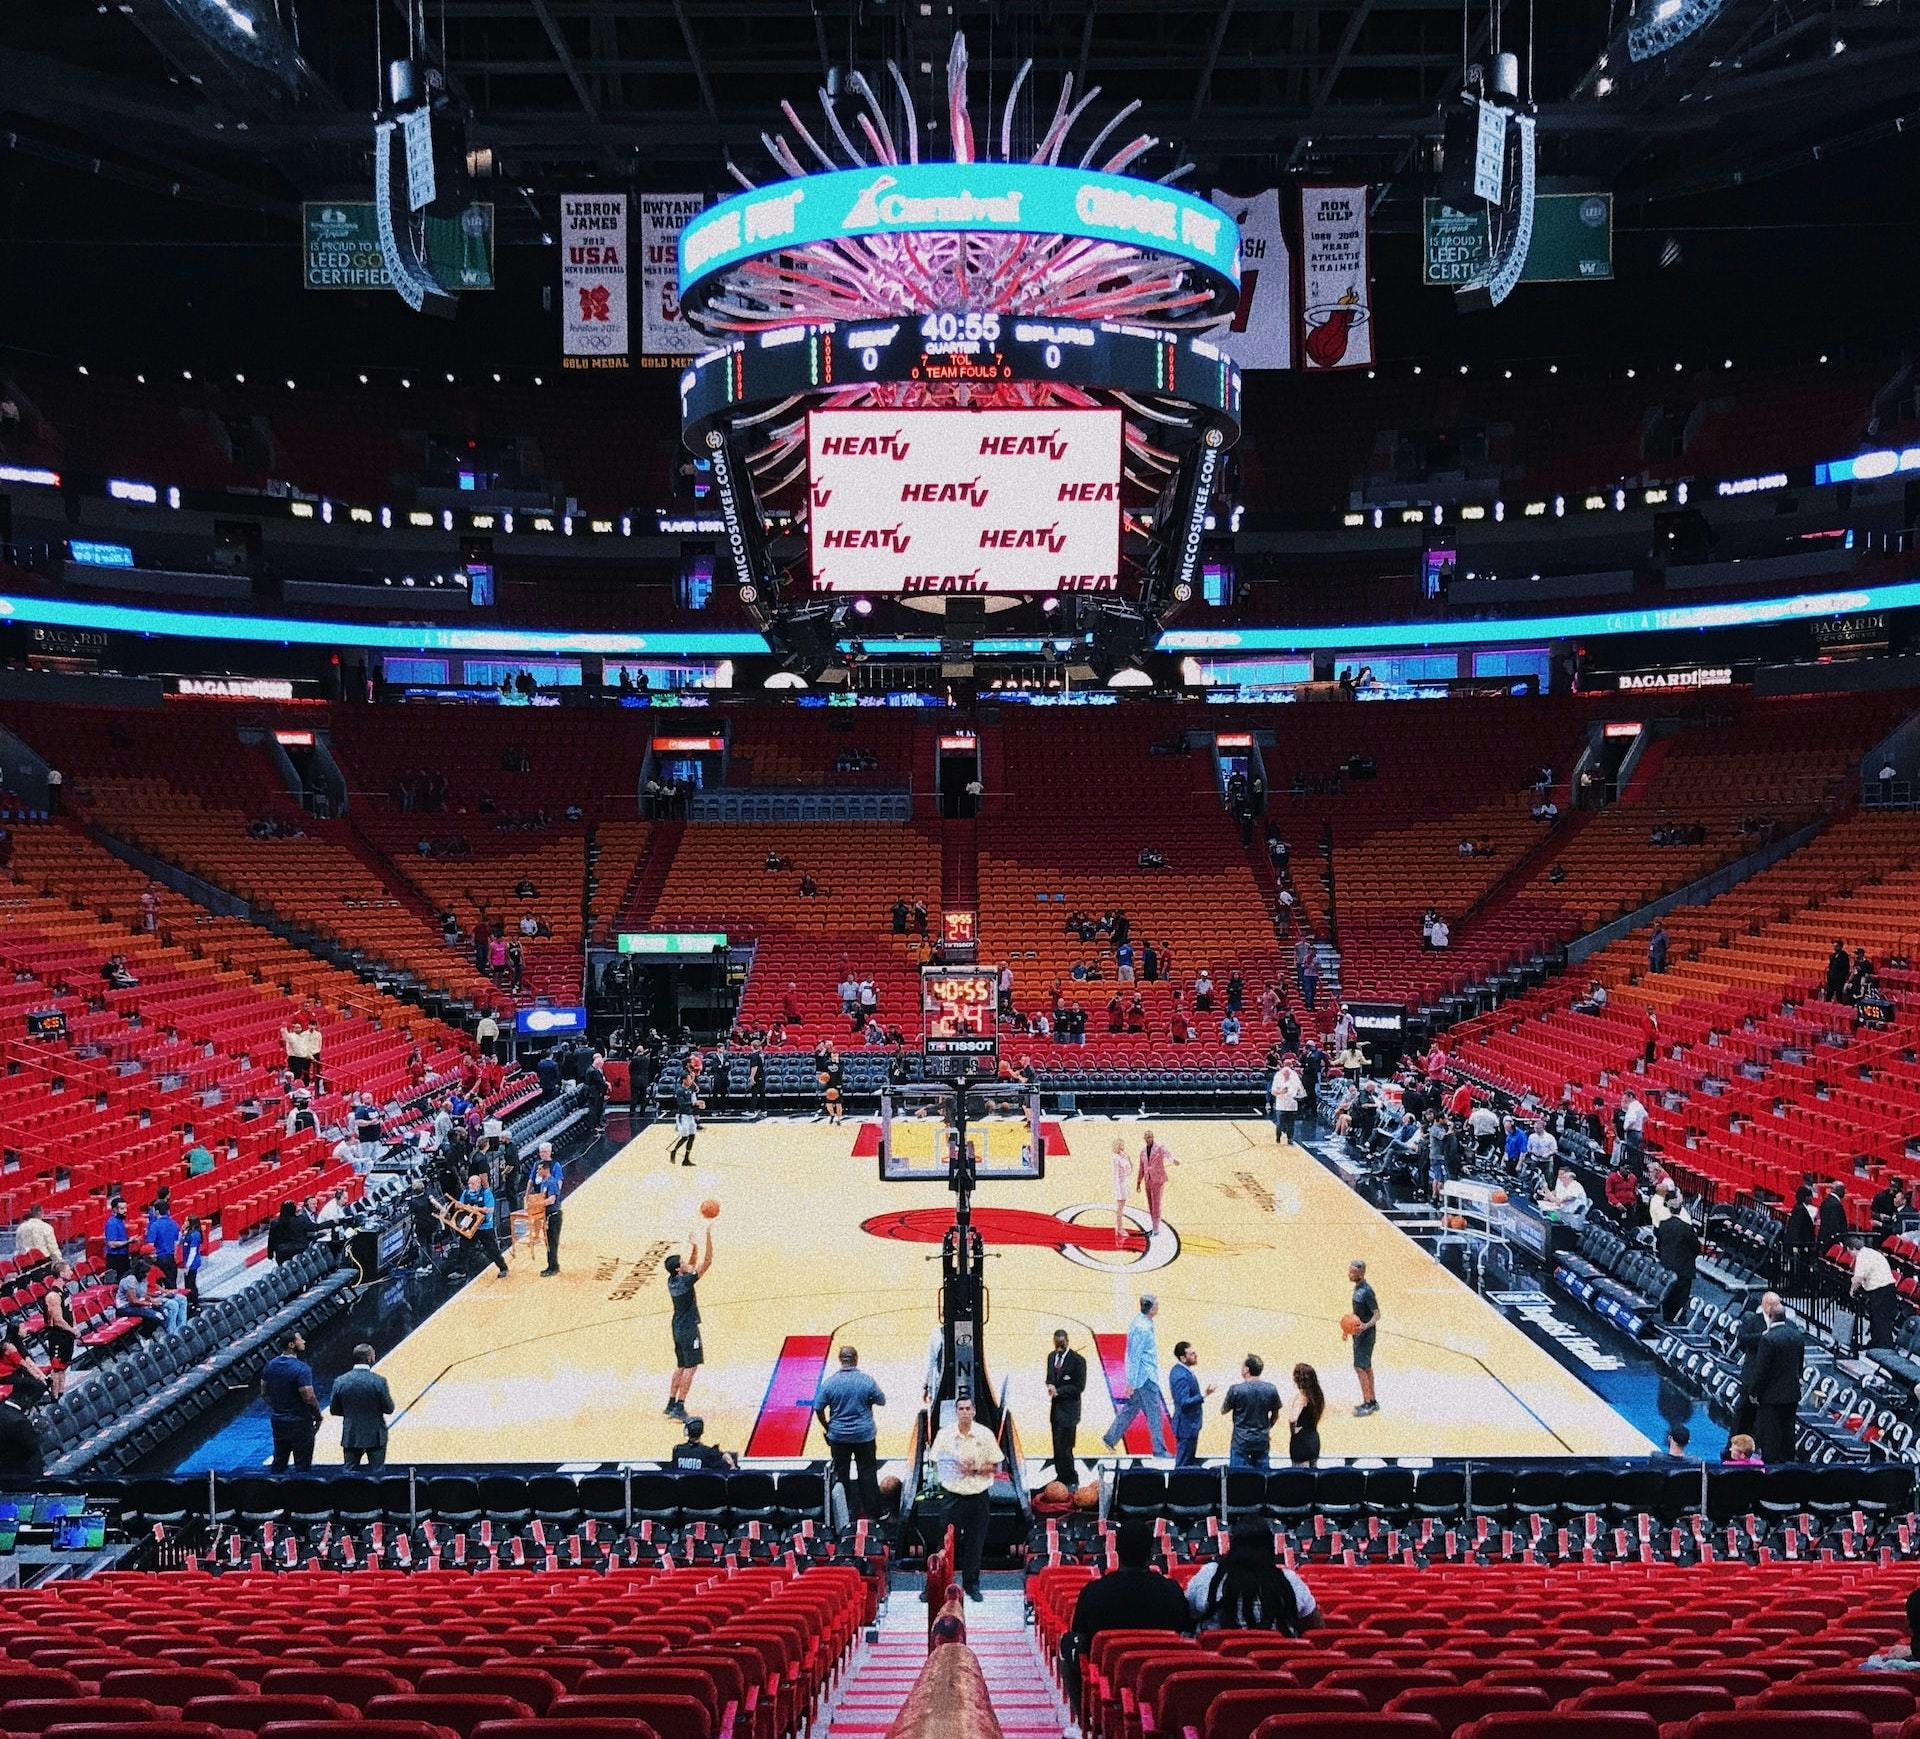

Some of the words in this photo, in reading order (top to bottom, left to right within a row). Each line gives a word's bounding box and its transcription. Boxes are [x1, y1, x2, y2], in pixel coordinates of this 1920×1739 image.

[566, 202, 621, 216] LEBRON
[1320, 201, 1350, 210] RON
[1317, 211, 1353, 221] CULP
[570, 217, 618, 230] JAMES
[1322, 243, 1349, 251] HEAD
[310, 253, 350, 268] LEED
[352, 253, 384, 268] GO
[569, 247, 619, 265] USA
[649, 246, 677, 264] US
[1429, 247, 1470, 262] LEED
[1311, 263, 1360, 272] TRAINER
[309, 269, 392, 285] CERTIFIED
[921, 313, 1001, 342] 40:55
[989, 342, 996, 354] 1
[563, 357, 589, 369] GOLD
[591, 357, 630, 369] MEDAL
[641, 357, 668, 369] GOLD
[862, 347, 879, 371] 0
[921, 355, 929, 366] 7
[950, 354, 972, 365] TOL
[996, 354, 1004, 365] 7
[1045, 345, 1061, 369] 0
[911, 369, 919, 379] 0
[926, 367, 957, 379] TEAM
[960, 367, 997, 378] FOULS
[1003, 367, 1011, 378] 0
[711, 450, 751, 583] MICCOSUKEE.COM
[1181, 449, 1217, 582] MICCOSUKEE.COM
[949, 924, 970, 940] 24
[933, 981, 989, 1001] 40:55
[941, 1002, 982, 1034] 24
[948, 1041, 993, 1051] TISSOT
[678, 1457, 702, 1470] PHOTO
